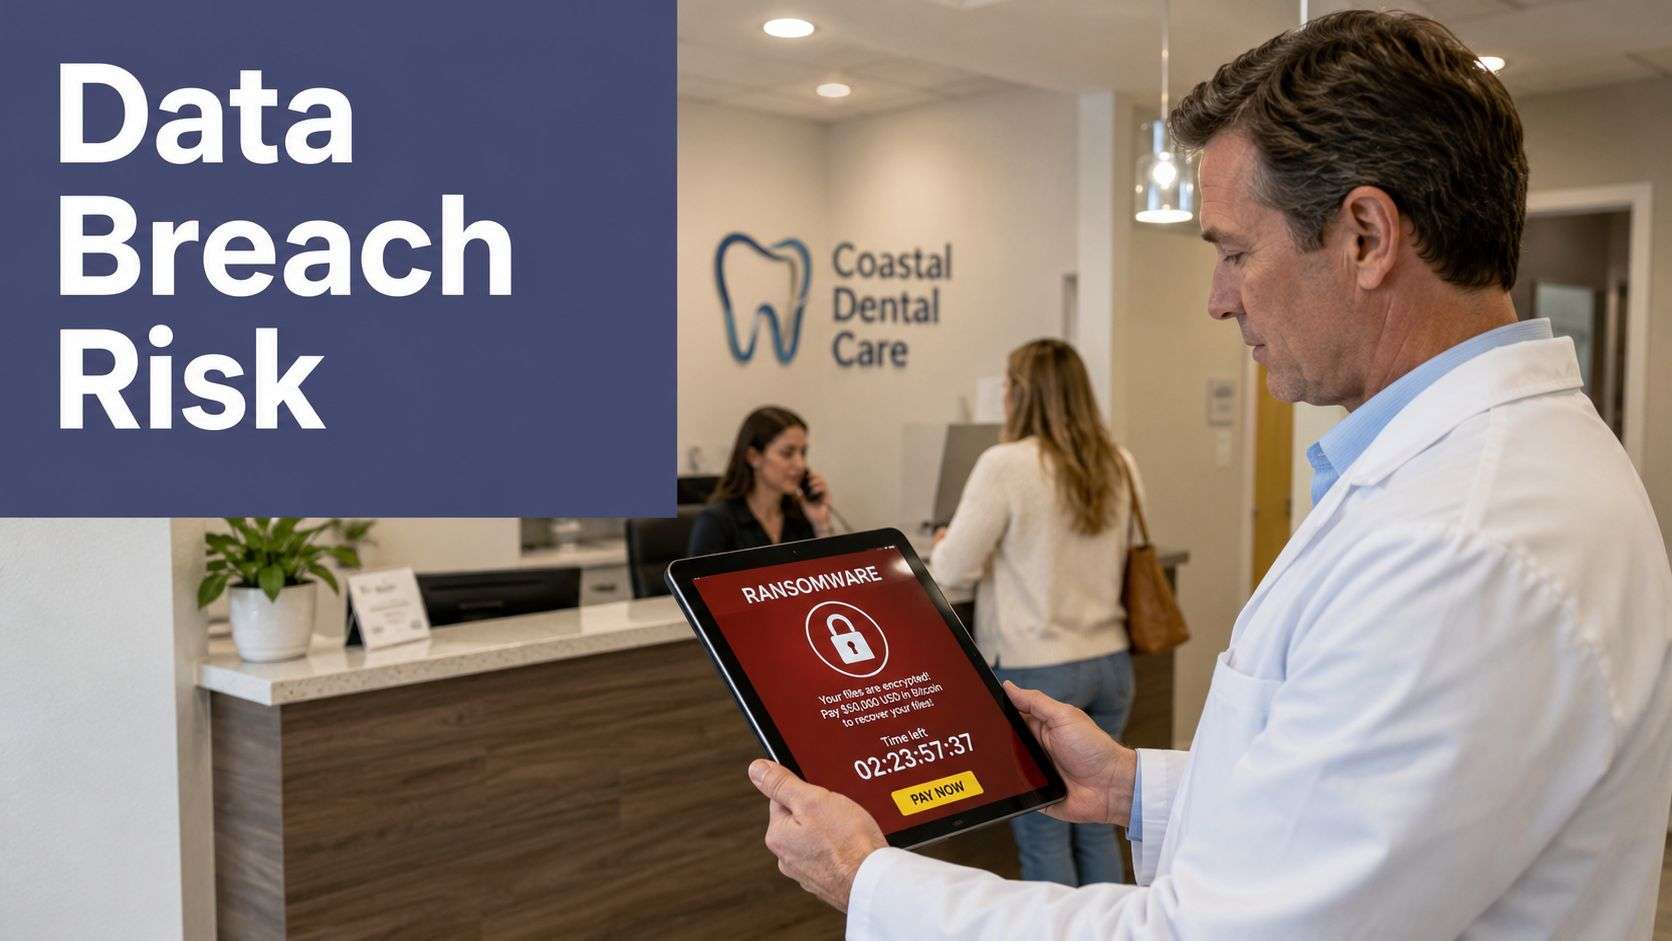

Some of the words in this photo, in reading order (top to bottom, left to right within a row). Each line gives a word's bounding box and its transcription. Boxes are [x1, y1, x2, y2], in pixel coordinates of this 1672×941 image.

[832, 242, 952, 280] Coastal
[832, 286, 940, 324] Dental
[832, 330, 909, 368] Care
[741, 565, 883, 604] RANSOMWARE
[818, 693, 842, 705] Your
[865, 685, 881, 695] are
[820, 708, 841, 720] Pay
[901, 690, 911, 700] in
[842, 718, 854, 728] to
[854, 710, 889, 725] recover
[889, 704, 911, 718] your
[880, 735, 909, 748] Time
[908, 727, 929, 741] left
[854, 732, 974, 780] 02:23:57:37
[910, 791, 934, 806] PAY
[934, 780, 965, 799] NOW
